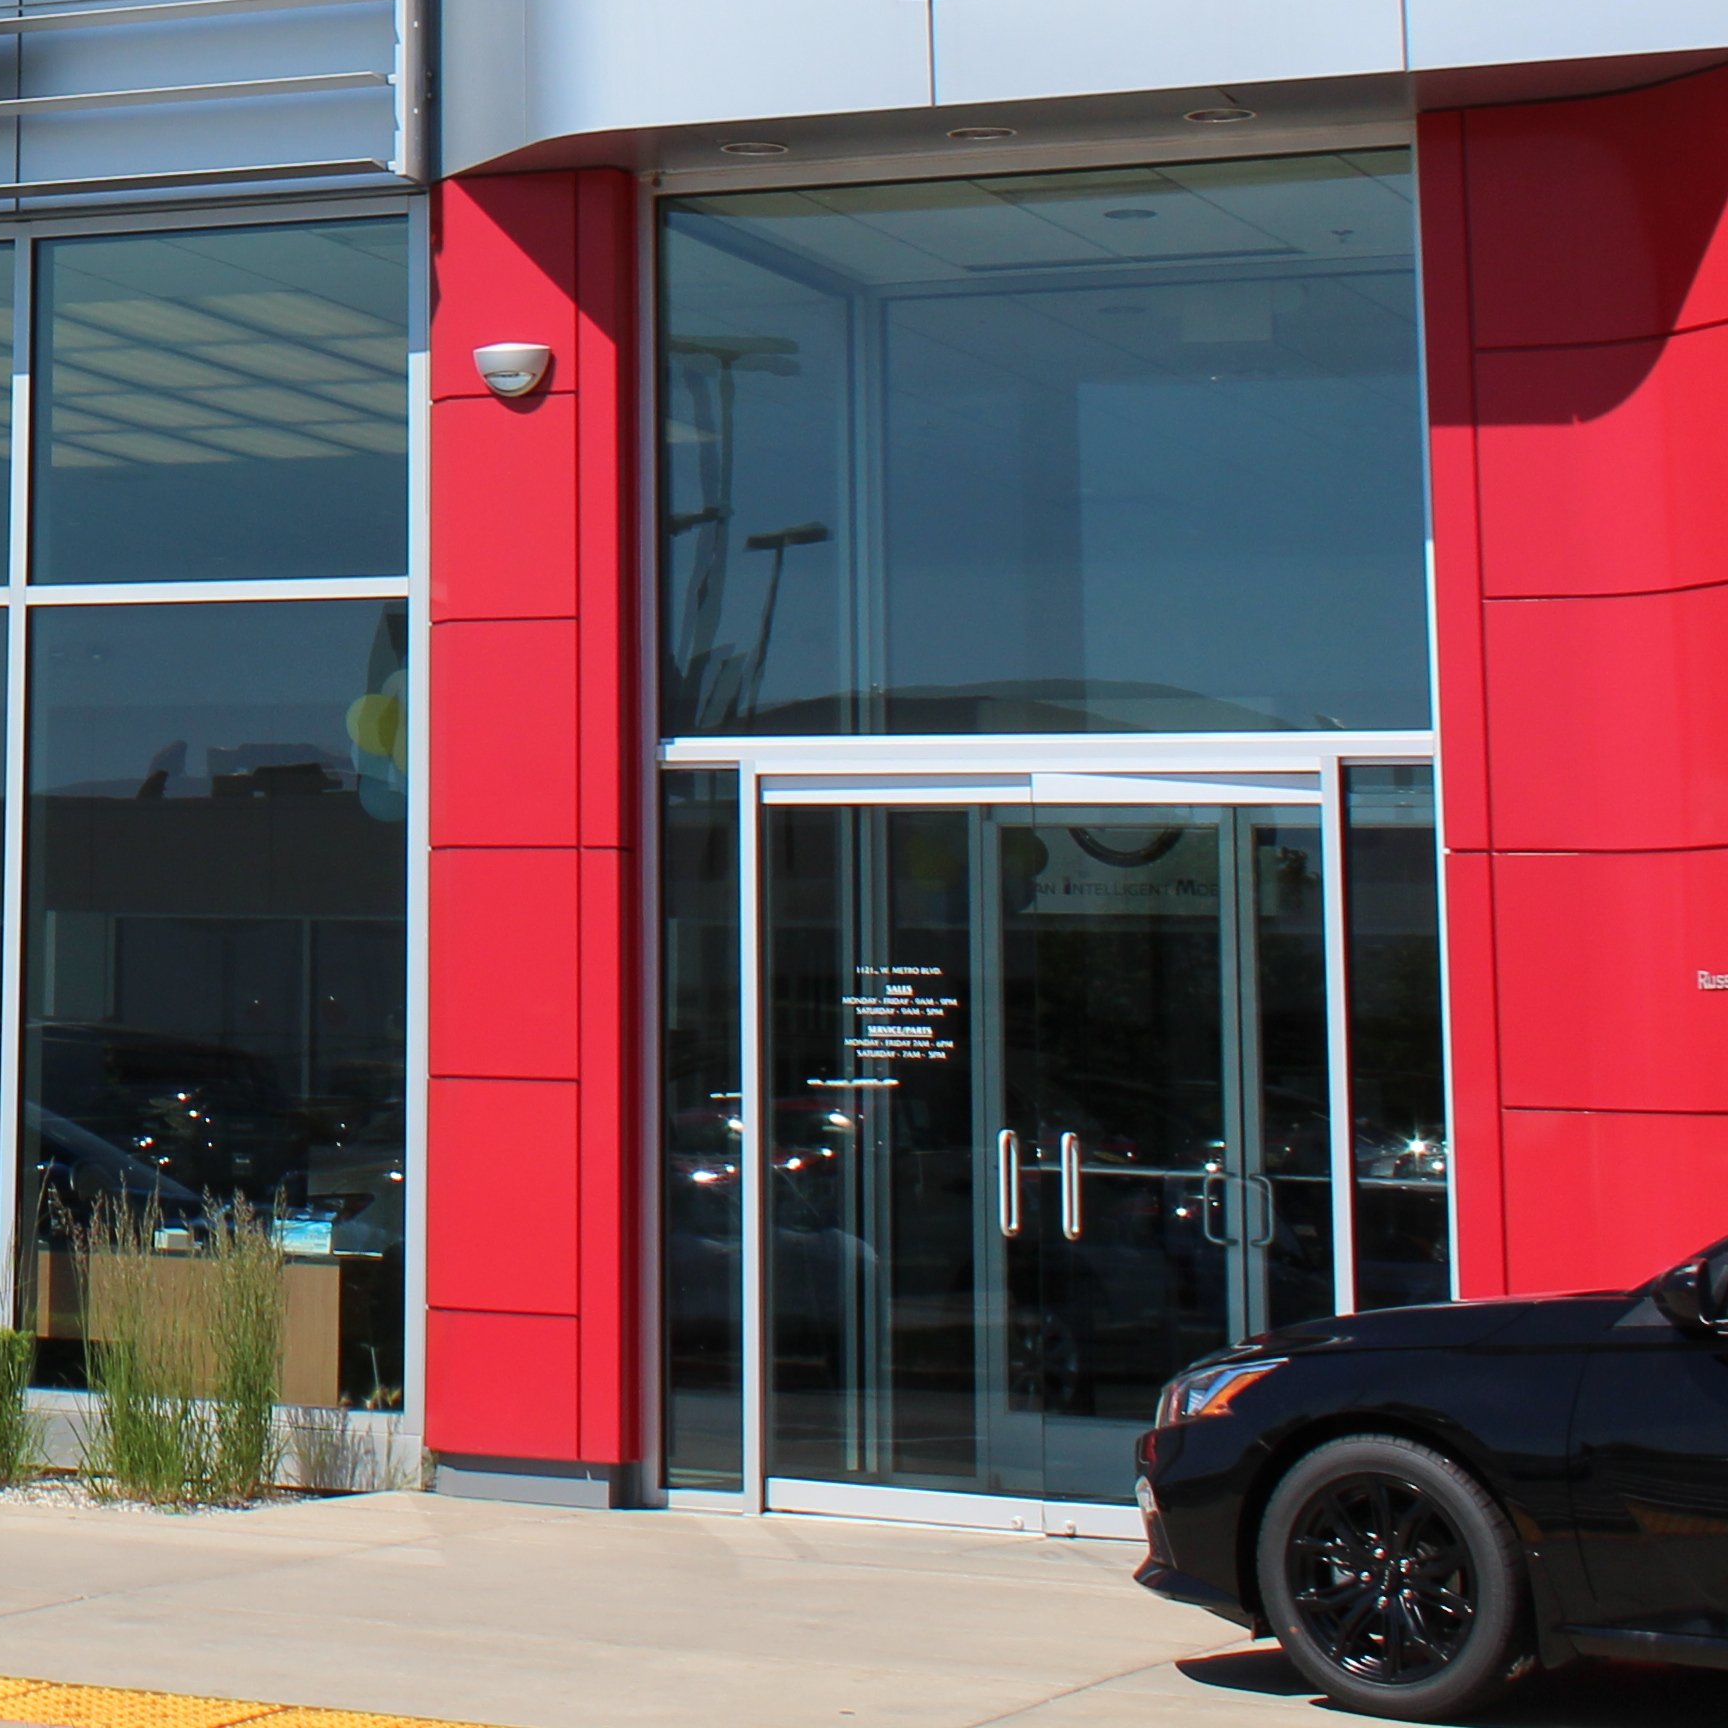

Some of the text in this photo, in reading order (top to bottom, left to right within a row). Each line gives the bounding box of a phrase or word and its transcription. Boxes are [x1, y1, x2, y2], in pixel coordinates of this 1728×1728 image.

[886, 985, 913, 994] SALES
[842, 997, 878, 1005] MONDAY
[883, 997, 910, 1005] FRIDAY
[856, 1007, 895, 1015] SATURDAY
[868, 1025, 933, 1036] SERVICE/PARTS
[844, 1038, 879, 1046] MONDAY
[885, 1039, 911, 1047] FRIDAY
[856, 1049, 896, 1058] SATURDAY
